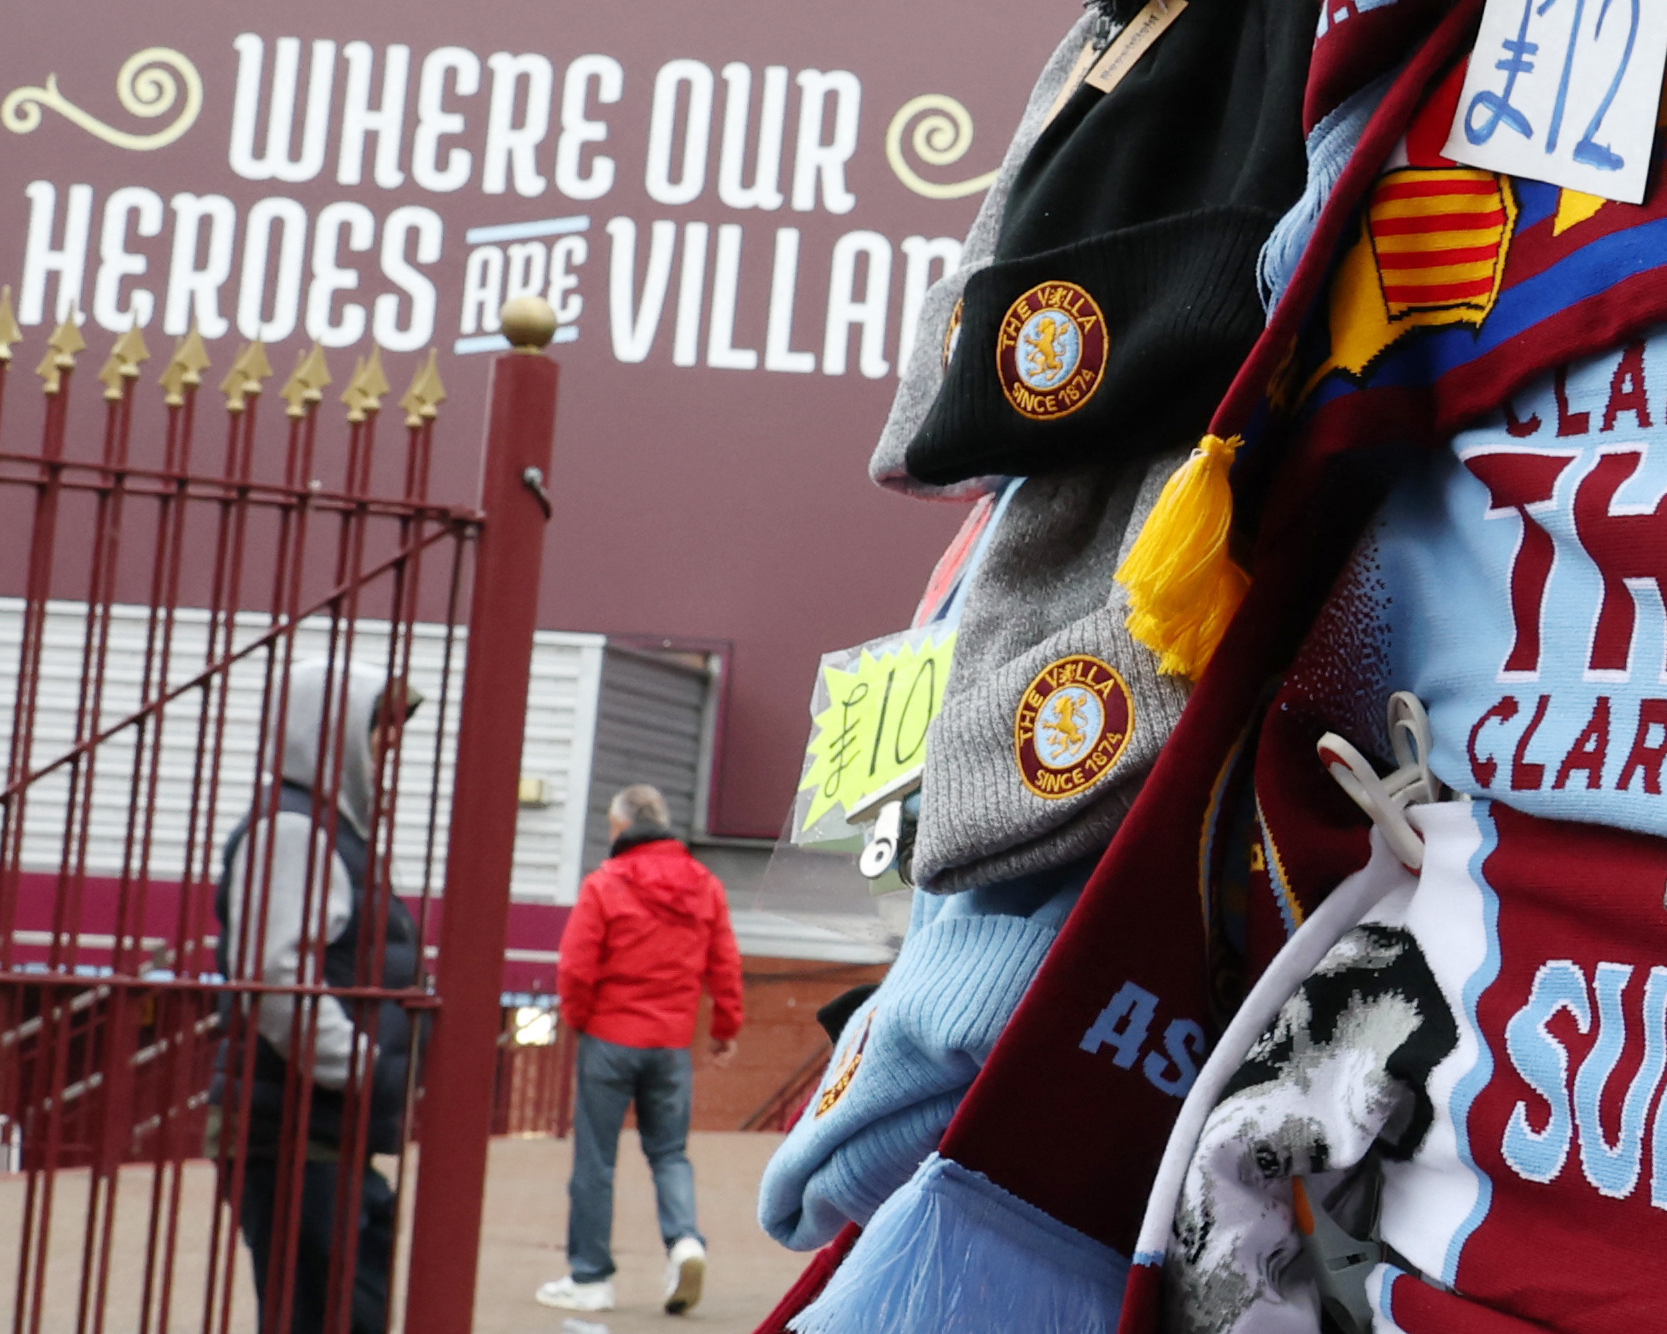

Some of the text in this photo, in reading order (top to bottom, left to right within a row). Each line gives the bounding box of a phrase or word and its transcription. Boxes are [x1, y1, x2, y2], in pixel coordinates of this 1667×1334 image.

[228, 33, 862, 214] WHERE OUR
[17, 180, 444, 353] HEROES
[459, 234, 588, 335] ARE
[605, 215, 964, 379] VILLAN
[1002, 300, 1032, 350] THE
[1012, 368, 1096, 412] SINCE 1874
[824, 657, 935, 799] £10
[1019, 689, 1044, 747] THE
[1034, 732, 1123, 793] SINCE 1874
